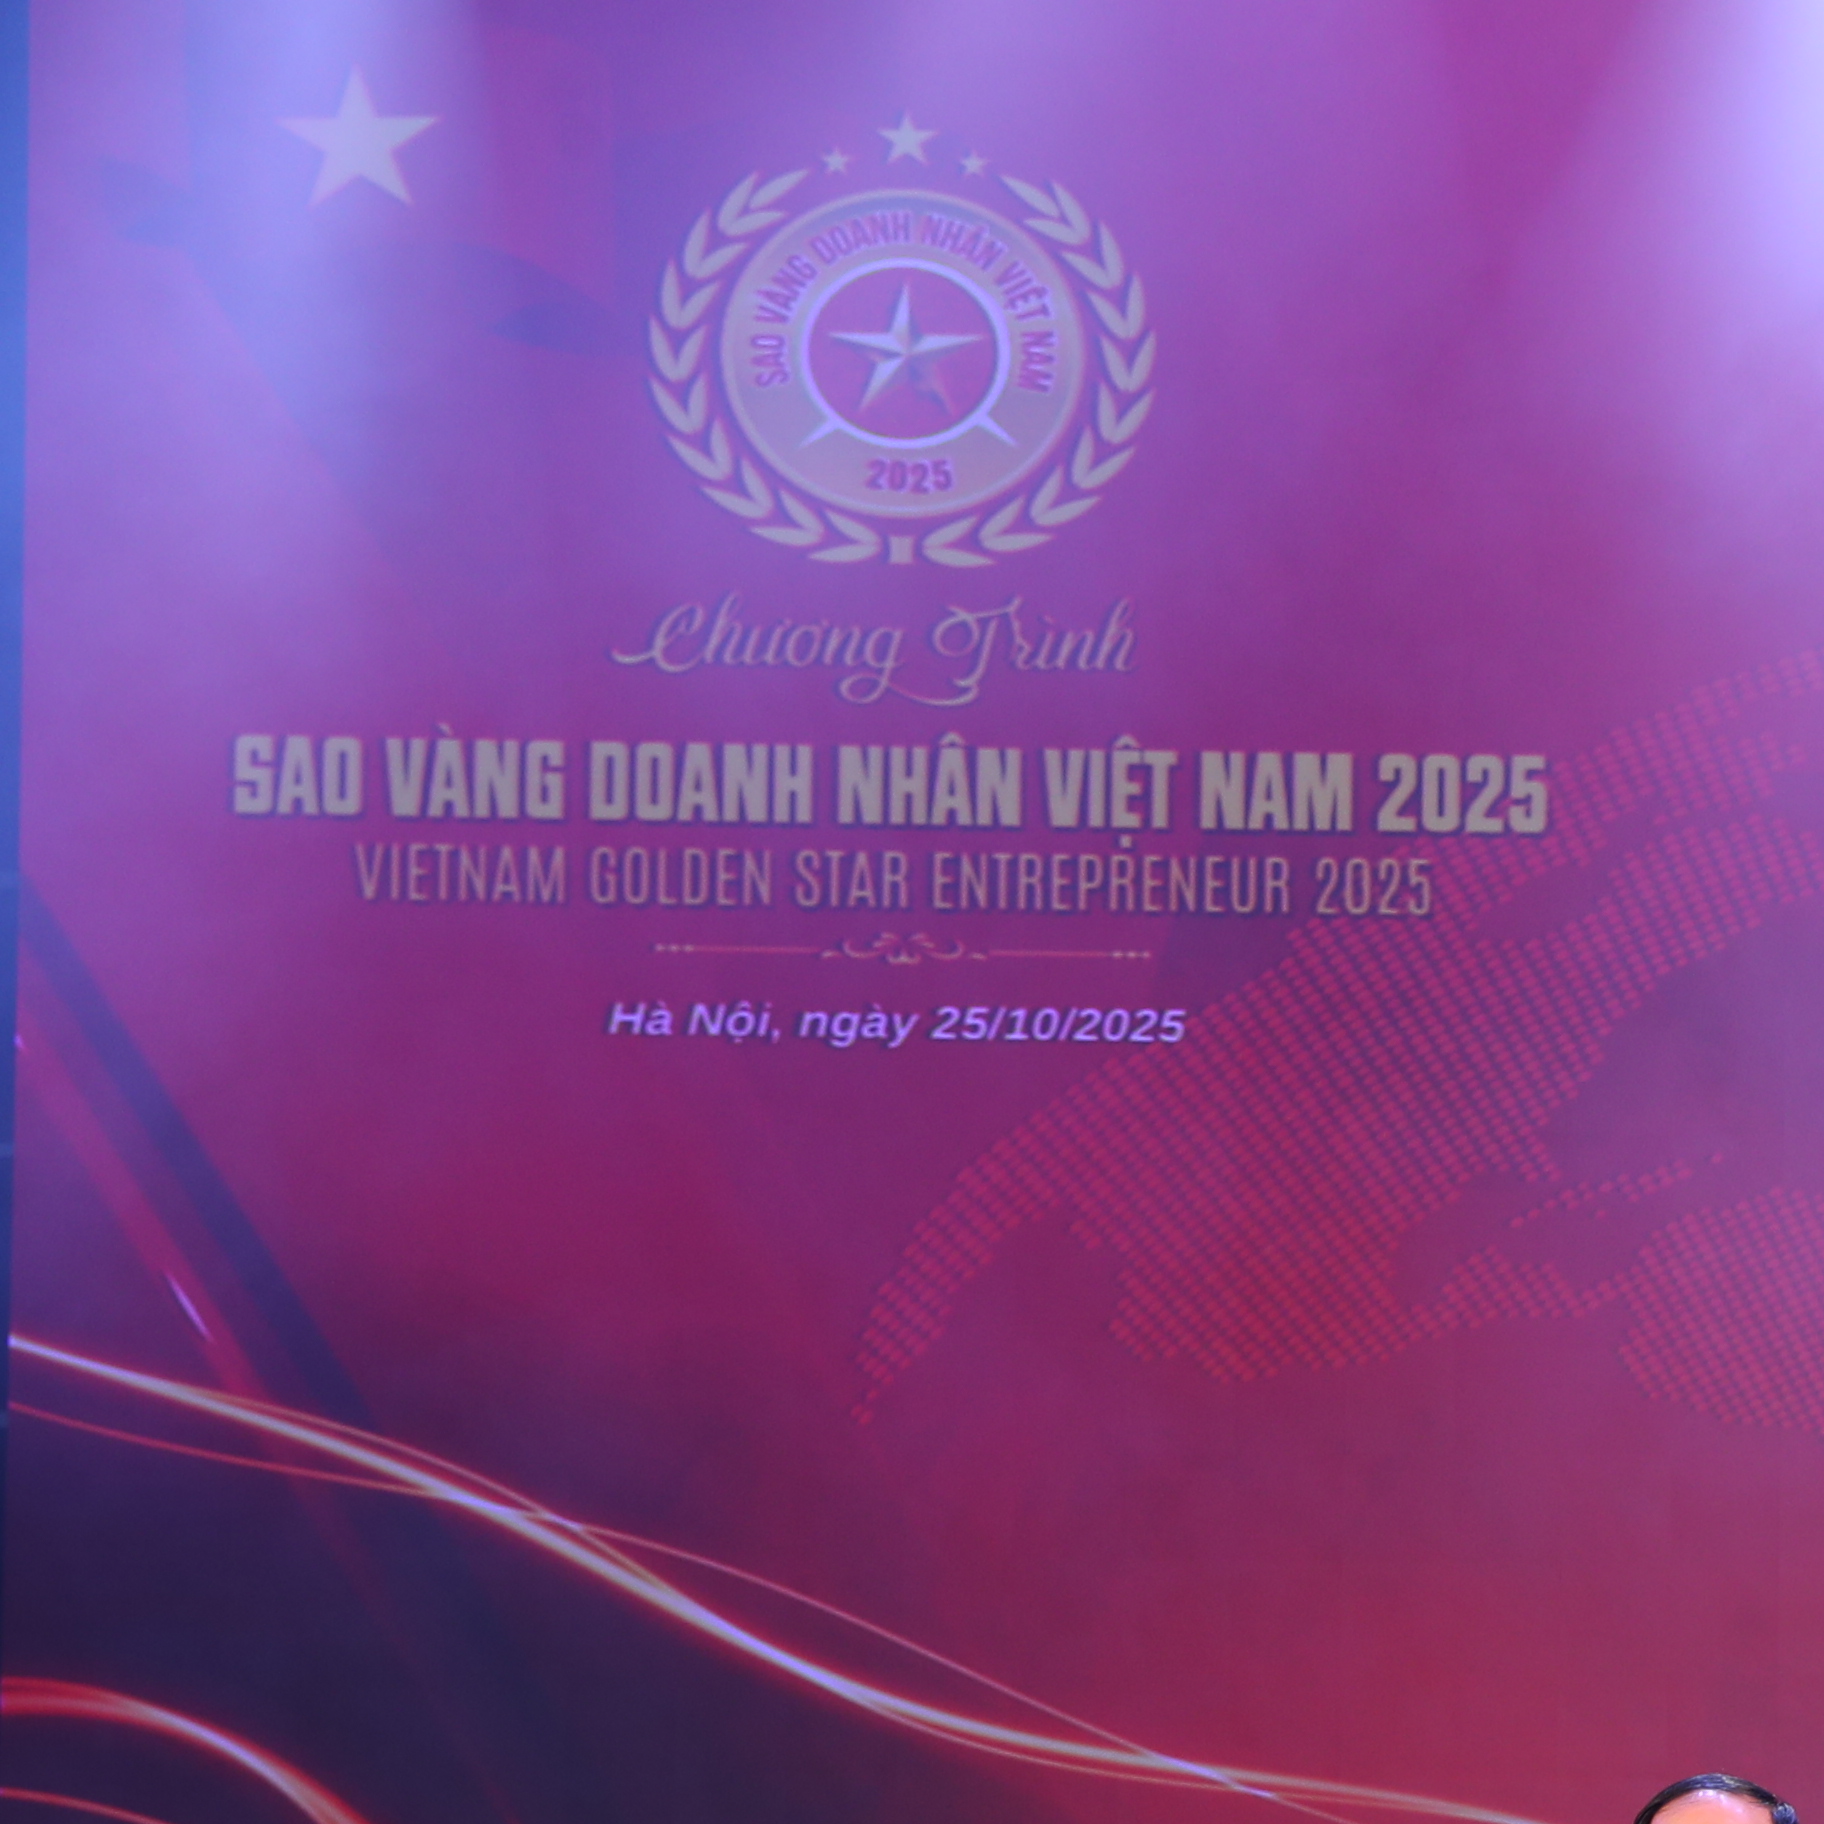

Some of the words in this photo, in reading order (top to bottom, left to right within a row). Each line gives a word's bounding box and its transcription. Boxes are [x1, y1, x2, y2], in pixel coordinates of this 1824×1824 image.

[750, 334, 790, 388] SAO
[811, 210, 913, 265] DOANH
[921, 213, 1008, 271] NHÂN
[1017, 330, 1060, 394] NAM
[865, 458, 953, 494] 2025
[232, 734, 363, 816] SAO
[385, 723, 566, 819] VÀNG
[588, 741, 812, 822] DOANH
[837, 731, 1022, 827] NHÂN
[1044, 734, 1179, 849] VIỆT
[1199, 750, 1353, 832] NAM
[1376, 753, 1549, 834] 2025
[355, 841, 566, 902] VIETNAM
[588, 846, 771, 907] GOLDEN
[795, 850, 908, 909] STAR
[932, 853, 1290, 915] ENTREPRENEUR
[1315, 857, 1432, 916] 2025
[608, 1001, 673, 1036] Hà
[688, 1001, 781, 1044] Nội,
[798, 1003, 918, 1048] ngày
[932, 1006, 1186, 1044] 25/10/2025
